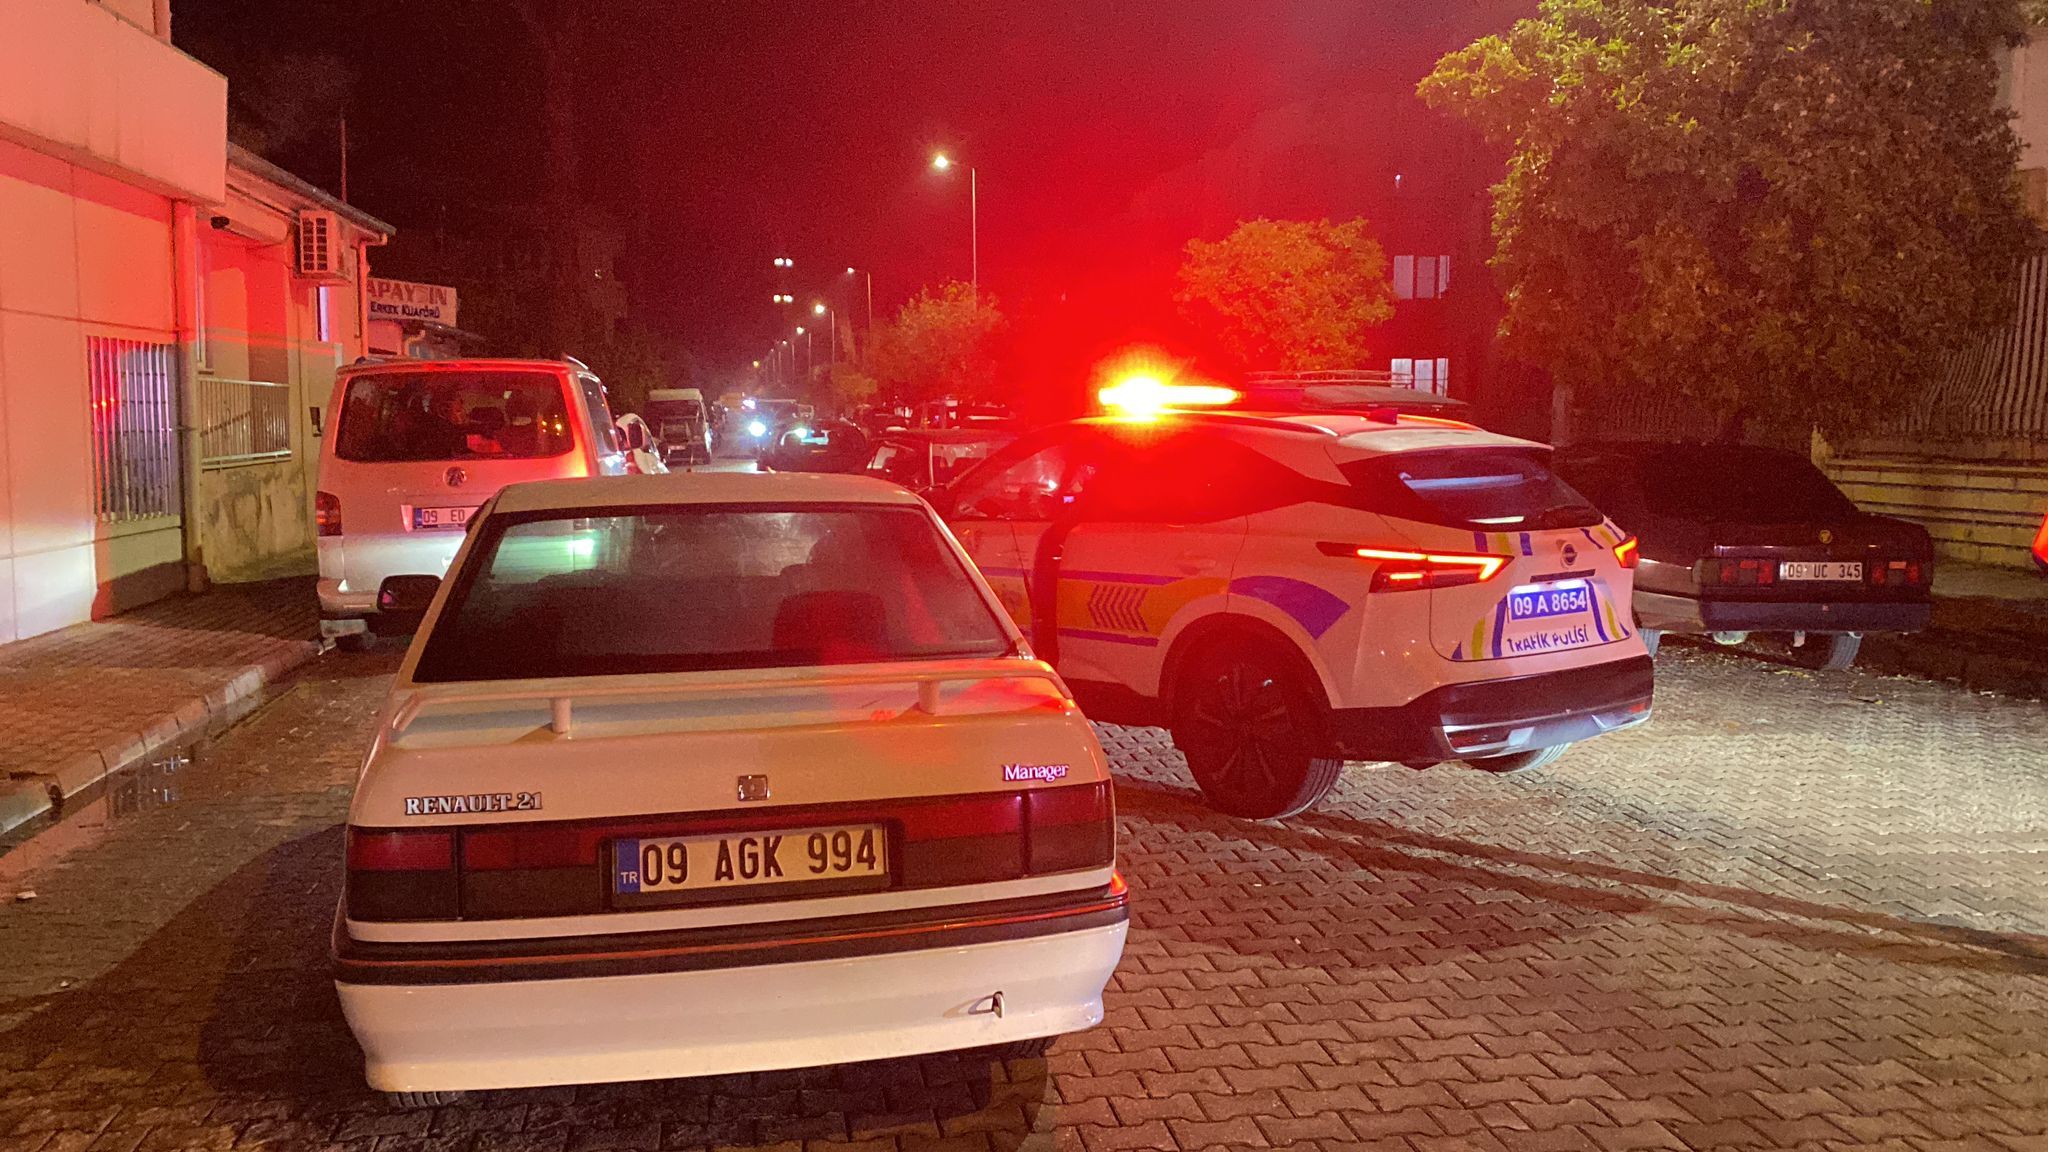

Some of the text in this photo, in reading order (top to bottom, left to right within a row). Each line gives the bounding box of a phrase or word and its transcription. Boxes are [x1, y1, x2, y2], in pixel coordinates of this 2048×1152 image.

[423, 510, 438, 523] 09
[1787, 563, 1861, 578] 09 UC 345
[1513, 590, 1587, 616] 09 A 8654
[1001, 763, 1070, 783] Manager
[404, 791, 543, 816] RENAULT 21
[642, 829, 877, 886] 09 AGK 994
[620, 871, 638, 885] TR
